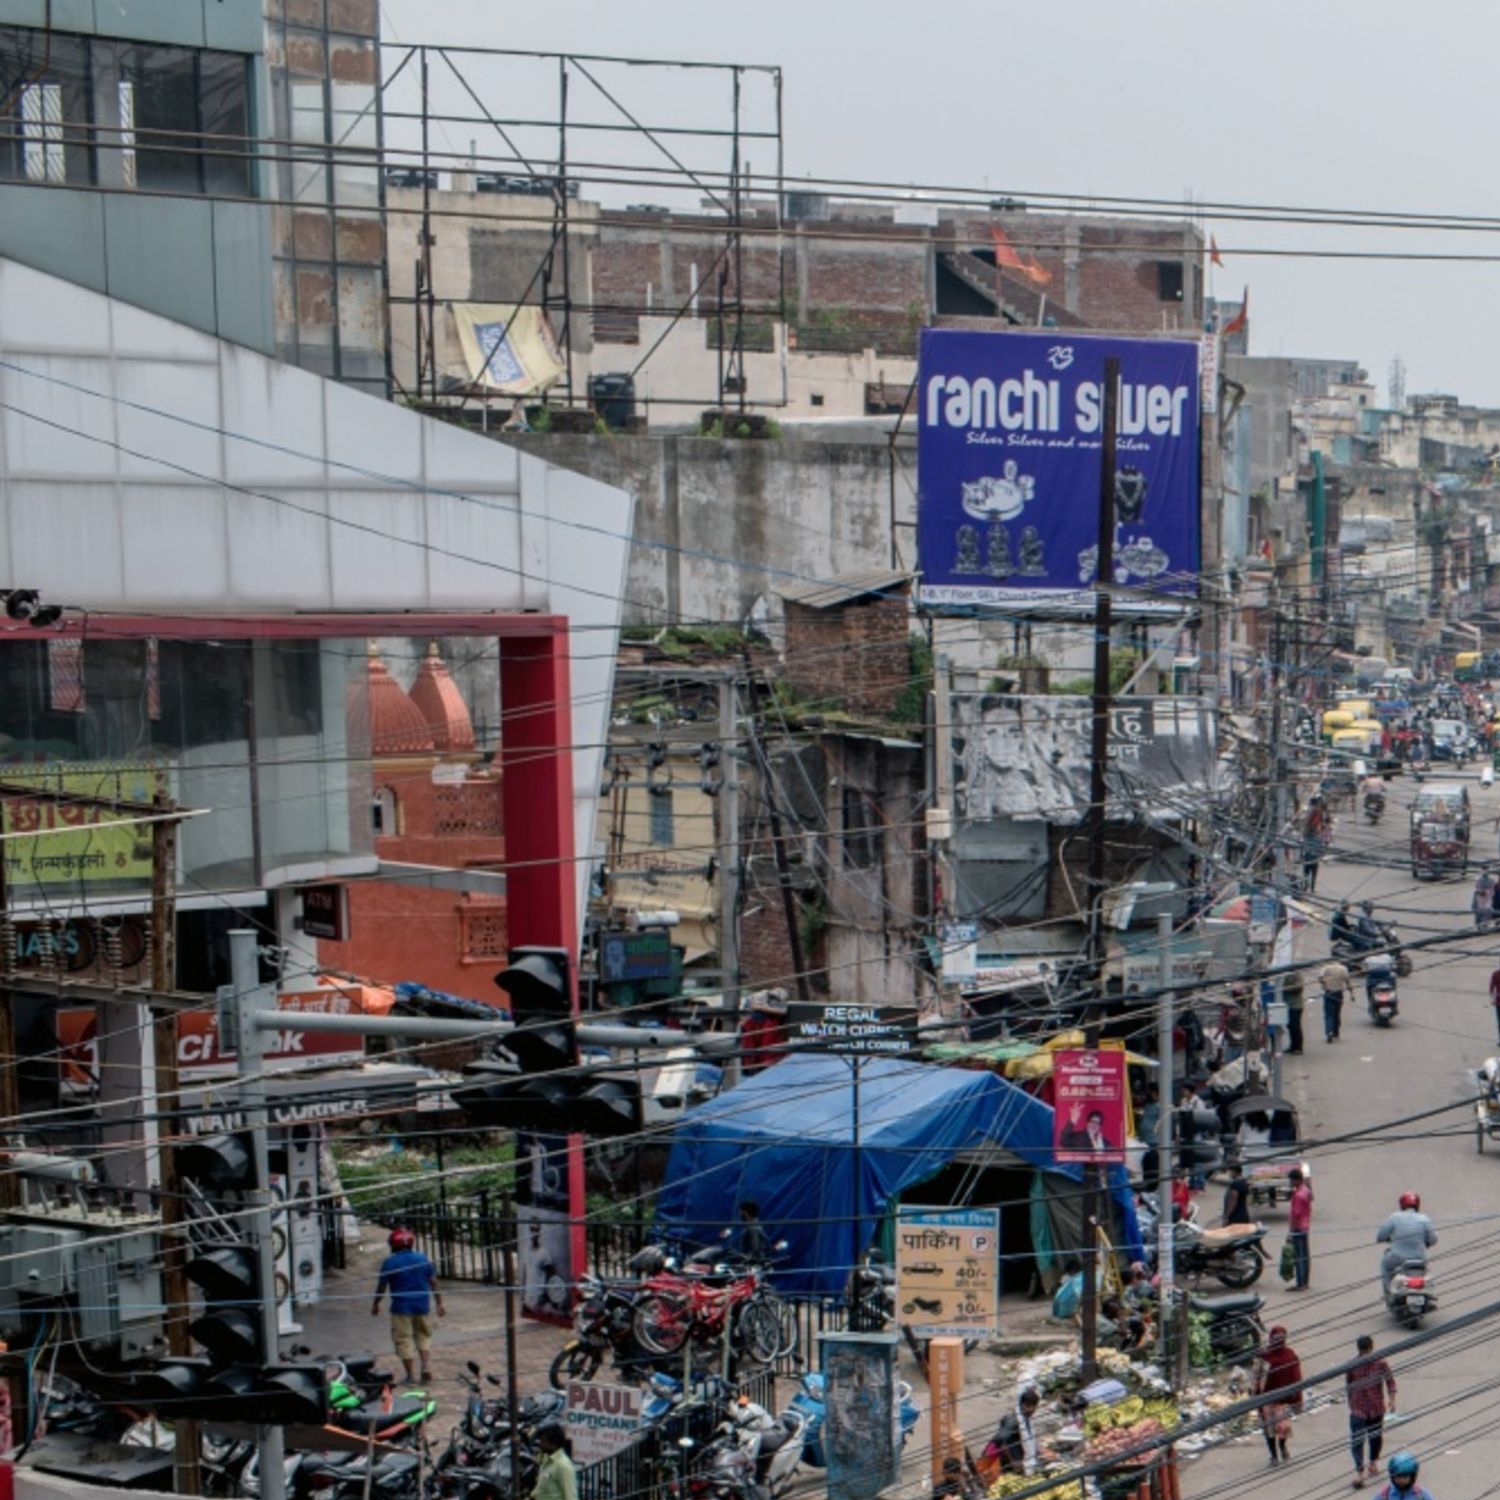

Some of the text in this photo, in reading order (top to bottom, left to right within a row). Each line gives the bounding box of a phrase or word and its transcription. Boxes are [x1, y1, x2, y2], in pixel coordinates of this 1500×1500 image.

[926, 369, 1059, 431] ranchi
[966, 431, 1003, 445] Silver
[1007, 433, 1045, 448] Silver
[824, 1007, 880, 1023] REGAL
[956, 1266, 987, 1279] 40/-
[956, 1302, 987, 1315] 10/-
[568, 1384, 640, 1416] PAUL
[567, 1411, 638, 1431] OPTICIANS
